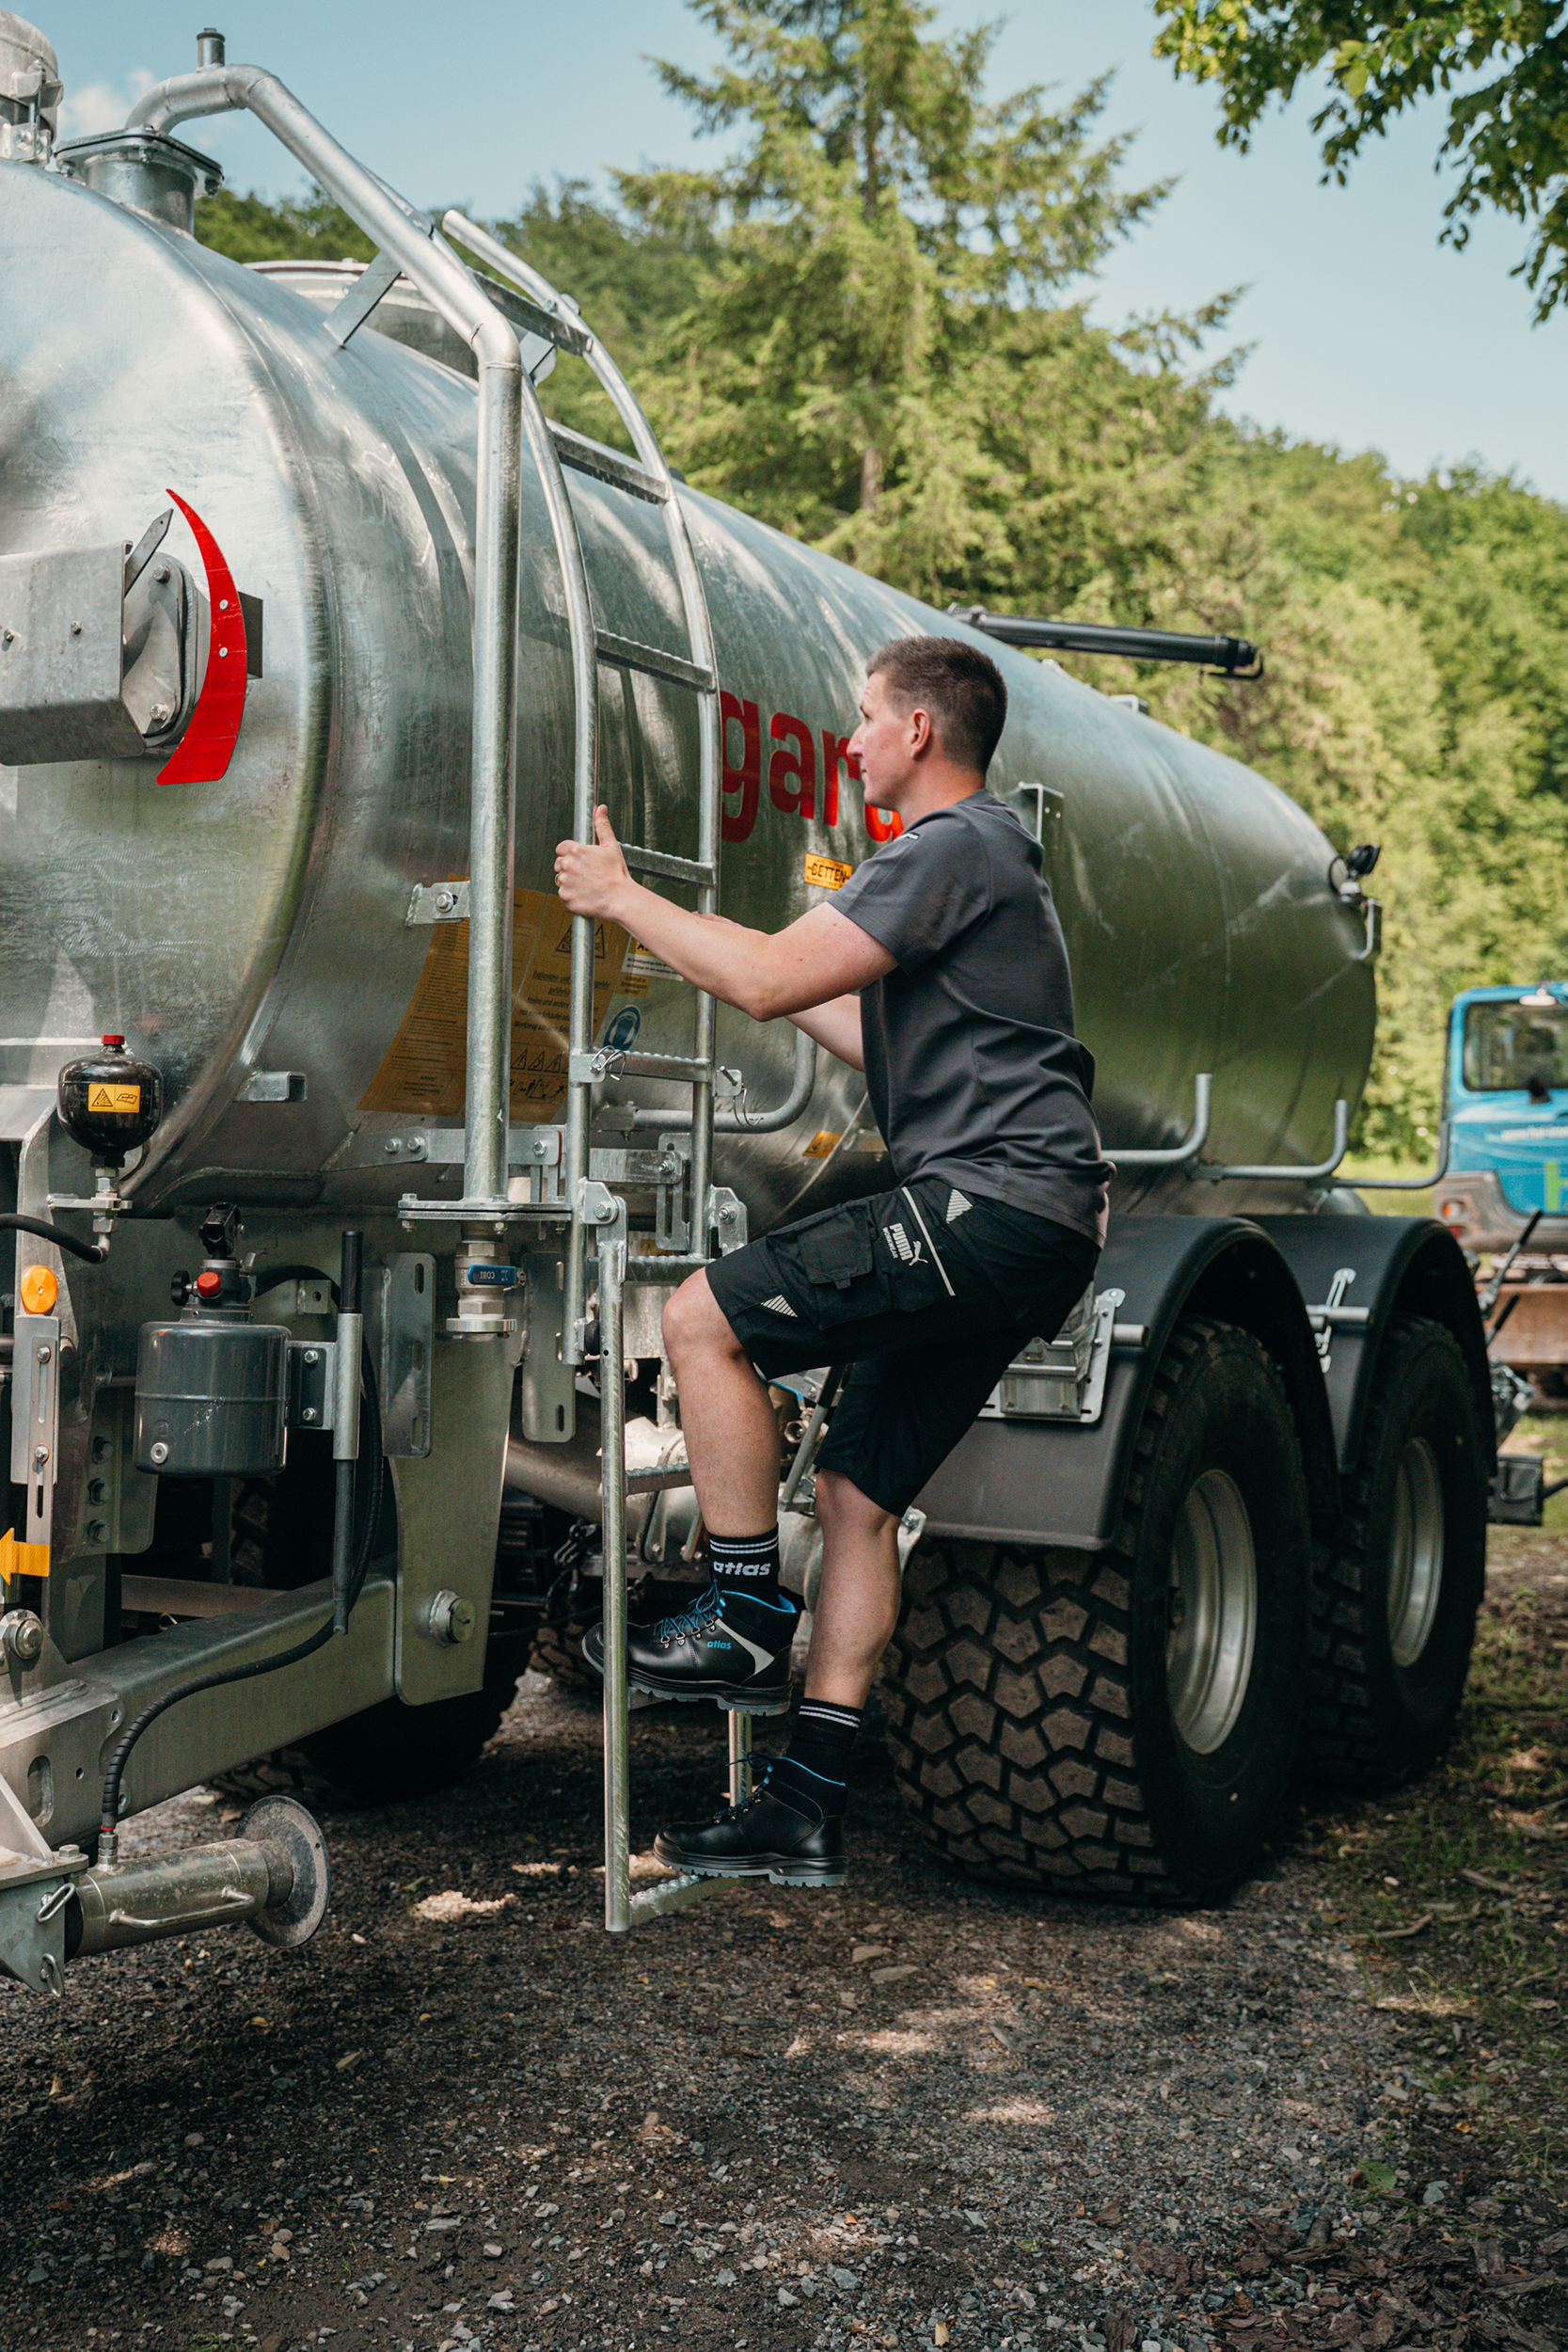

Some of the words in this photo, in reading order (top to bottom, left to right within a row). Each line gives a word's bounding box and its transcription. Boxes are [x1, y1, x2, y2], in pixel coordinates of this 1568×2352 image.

[882, 1226, 899, 1259] WORKWEAR
[889, 1222, 913, 1261] PUMA
[713, 1561, 771, 1576] atlas
[706, 1640, 732, 1650] atlas
